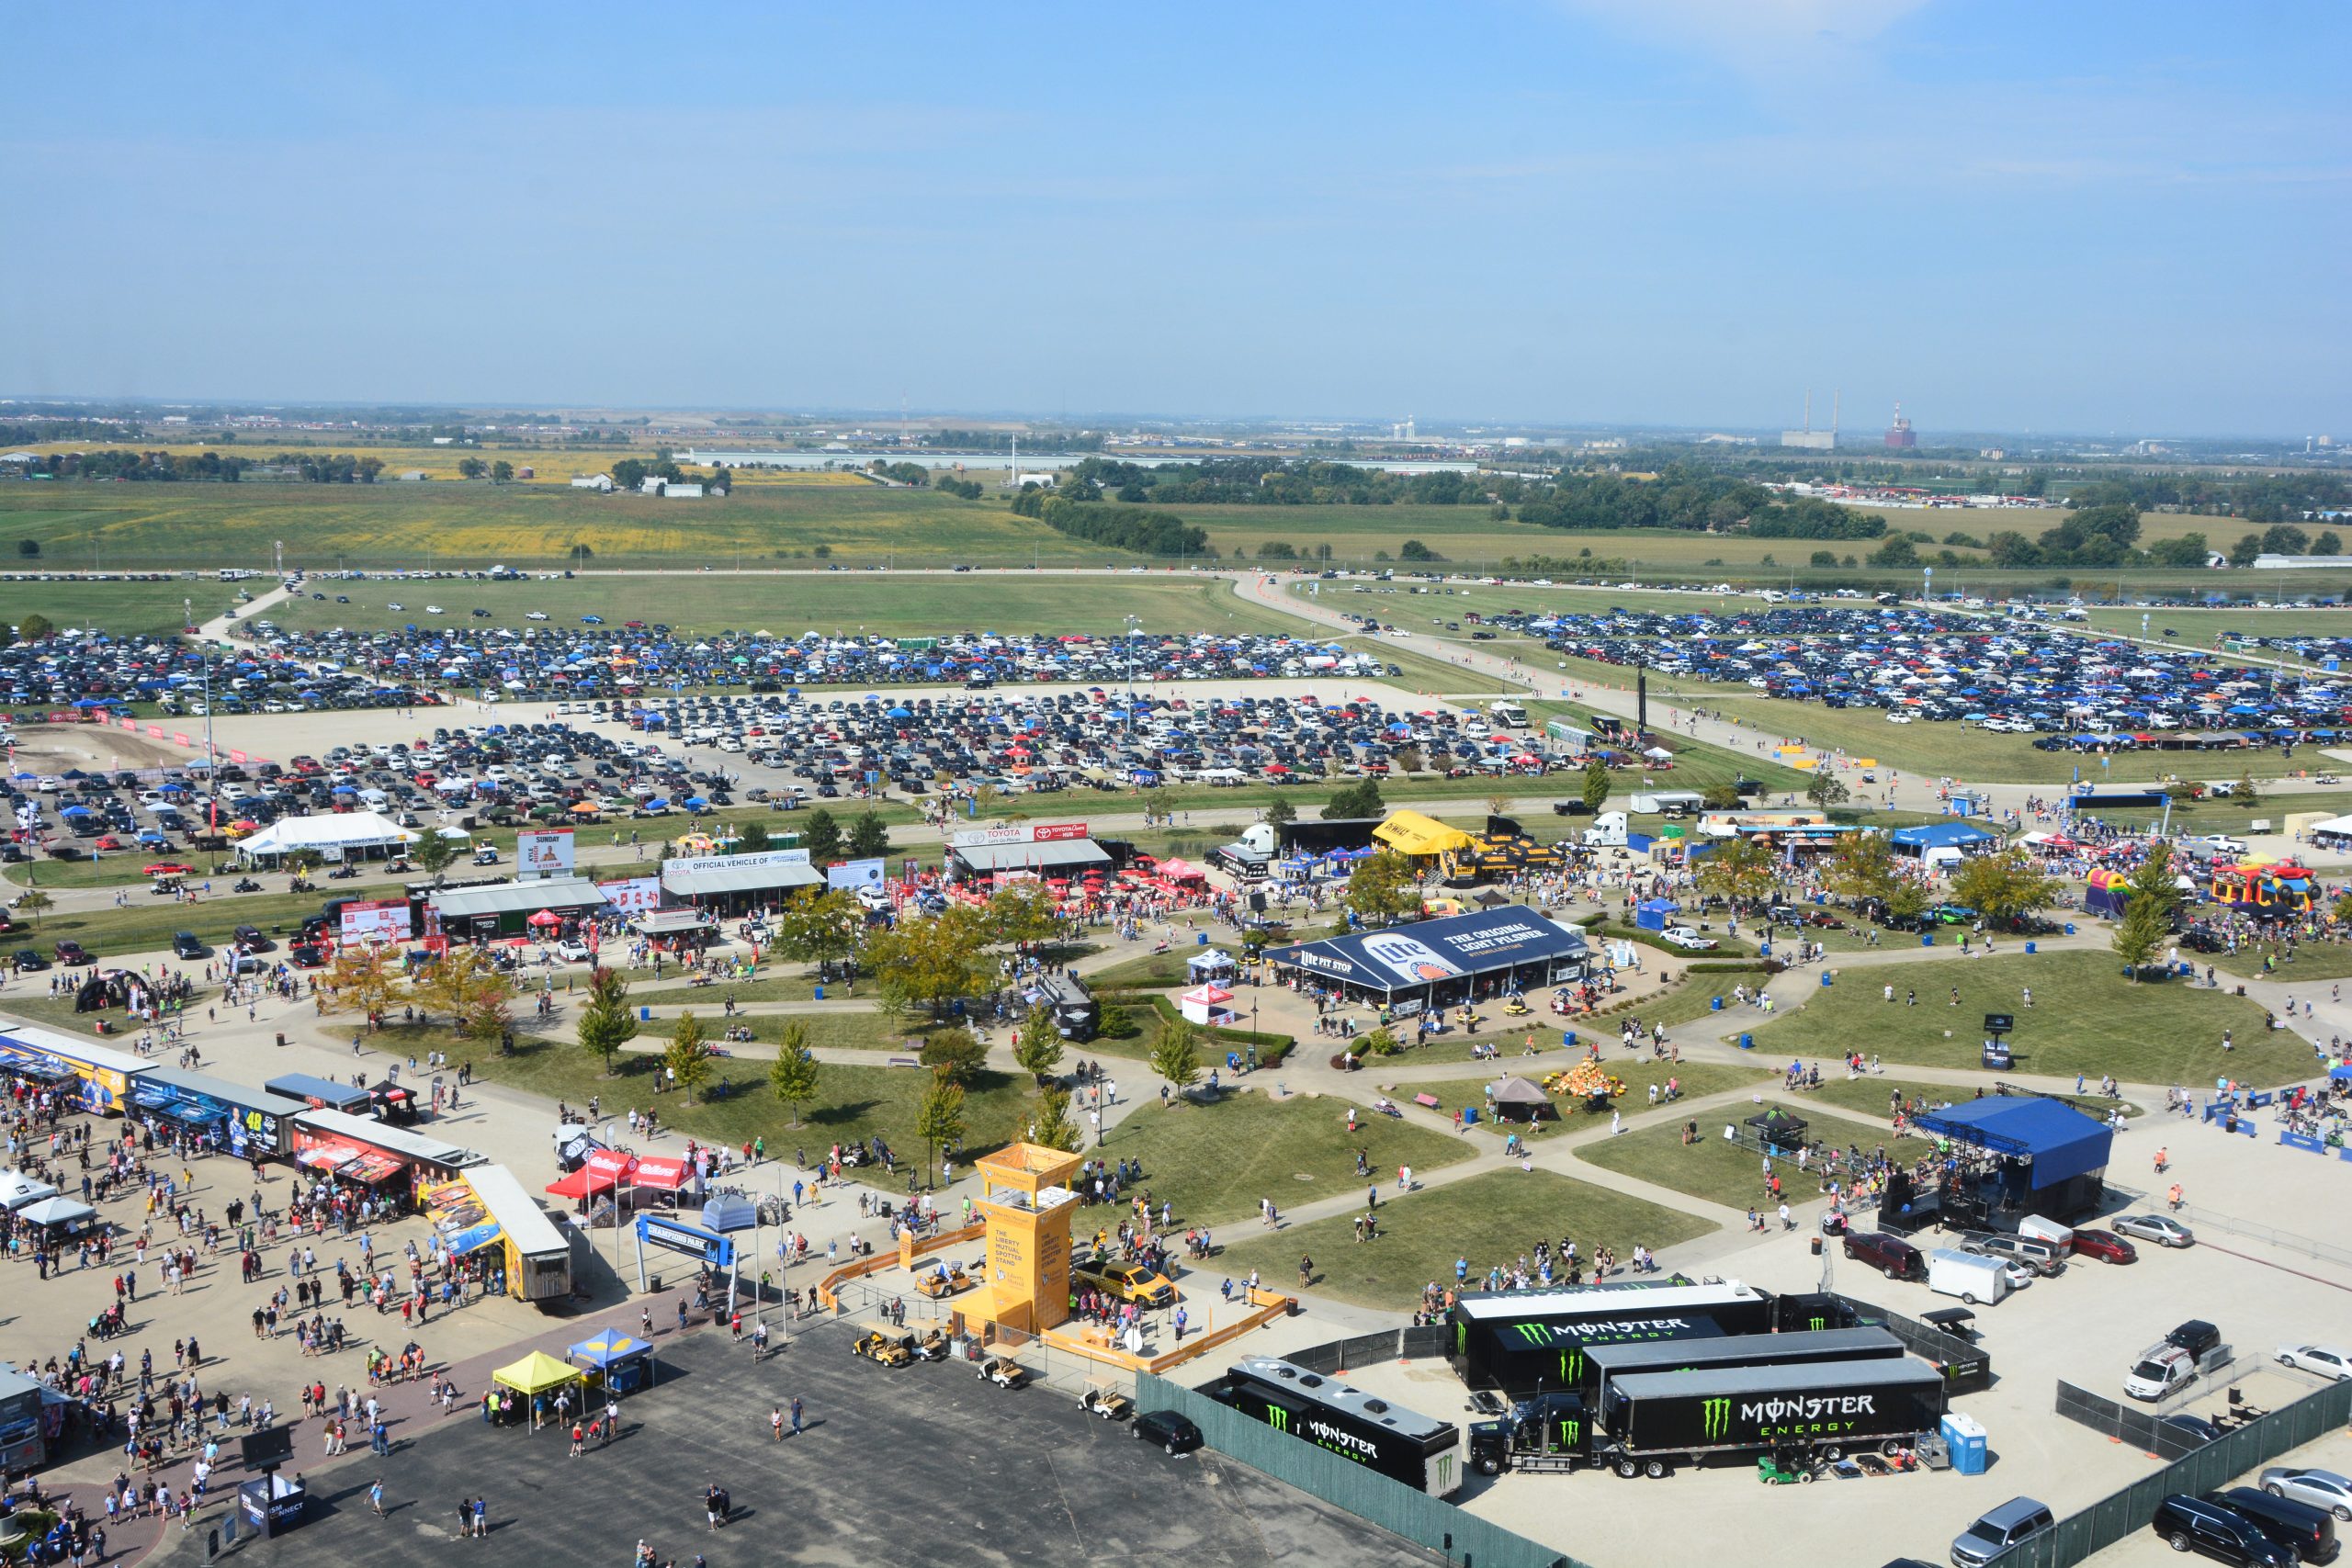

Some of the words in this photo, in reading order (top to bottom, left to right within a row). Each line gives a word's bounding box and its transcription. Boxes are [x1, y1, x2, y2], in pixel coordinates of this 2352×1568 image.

[304, 840, 339, 849] Raceway
[341, 837, 379, 845] Ministries
[694, 862, 726, 870] OFFICIAL
[728, 859, 757, 867] VEHICLE
[1443, 933, 1475, 945] THE
[1472, 923, 1532, 939] ORIGINAL
[1455, 939, 1497, 953] LIGHT
[1495, 930, 1549, 945] PILSNER.
[1371, 942, 1426, 964] Lite
[1301, 950, 1318, 966] Lite
[1318, 957, 1331, 968] PIT
[1332, 961, 1352, 973] STOP
[110, 1073, 122, 1087] 24
[246, 1111, 262, 1132] 48
[648, 1226, 687, 1244] CHAMPIONS
[687, 1237, 705, 1249] PARK
[996, 1236, 1020, 1247] LIBERTY
[1042, 1235, 1059, 1247] LIBERTY
[996, 1244, 1020, 1254] MUTUAL
[1042, 1242, 1059, 1255] MUTUAL
[1042, 1248, 1062, 1262] SPOTTER
[996, 1250, 1023, 1261] SPOTTER
[996, 1257, 1015, 1267] STAND
[1042, 1258, 1057, 1268] STAND
[1007, 1271, 1023, 1281] Liberty
[1008, 1278, 1024, 1287] Mutual
[1552, 1318, 1690, 1337] MONSTER
[1581, 1331, 1675, 1342] ENERGY
[1741, 1395, 1876, 1424] MONSTER
[1761, 1421, 1854, 1436] ENERGY
[1317, 1438, 1367, 1463] ENERGY
[269, 1505, 283, 1515] ISM
